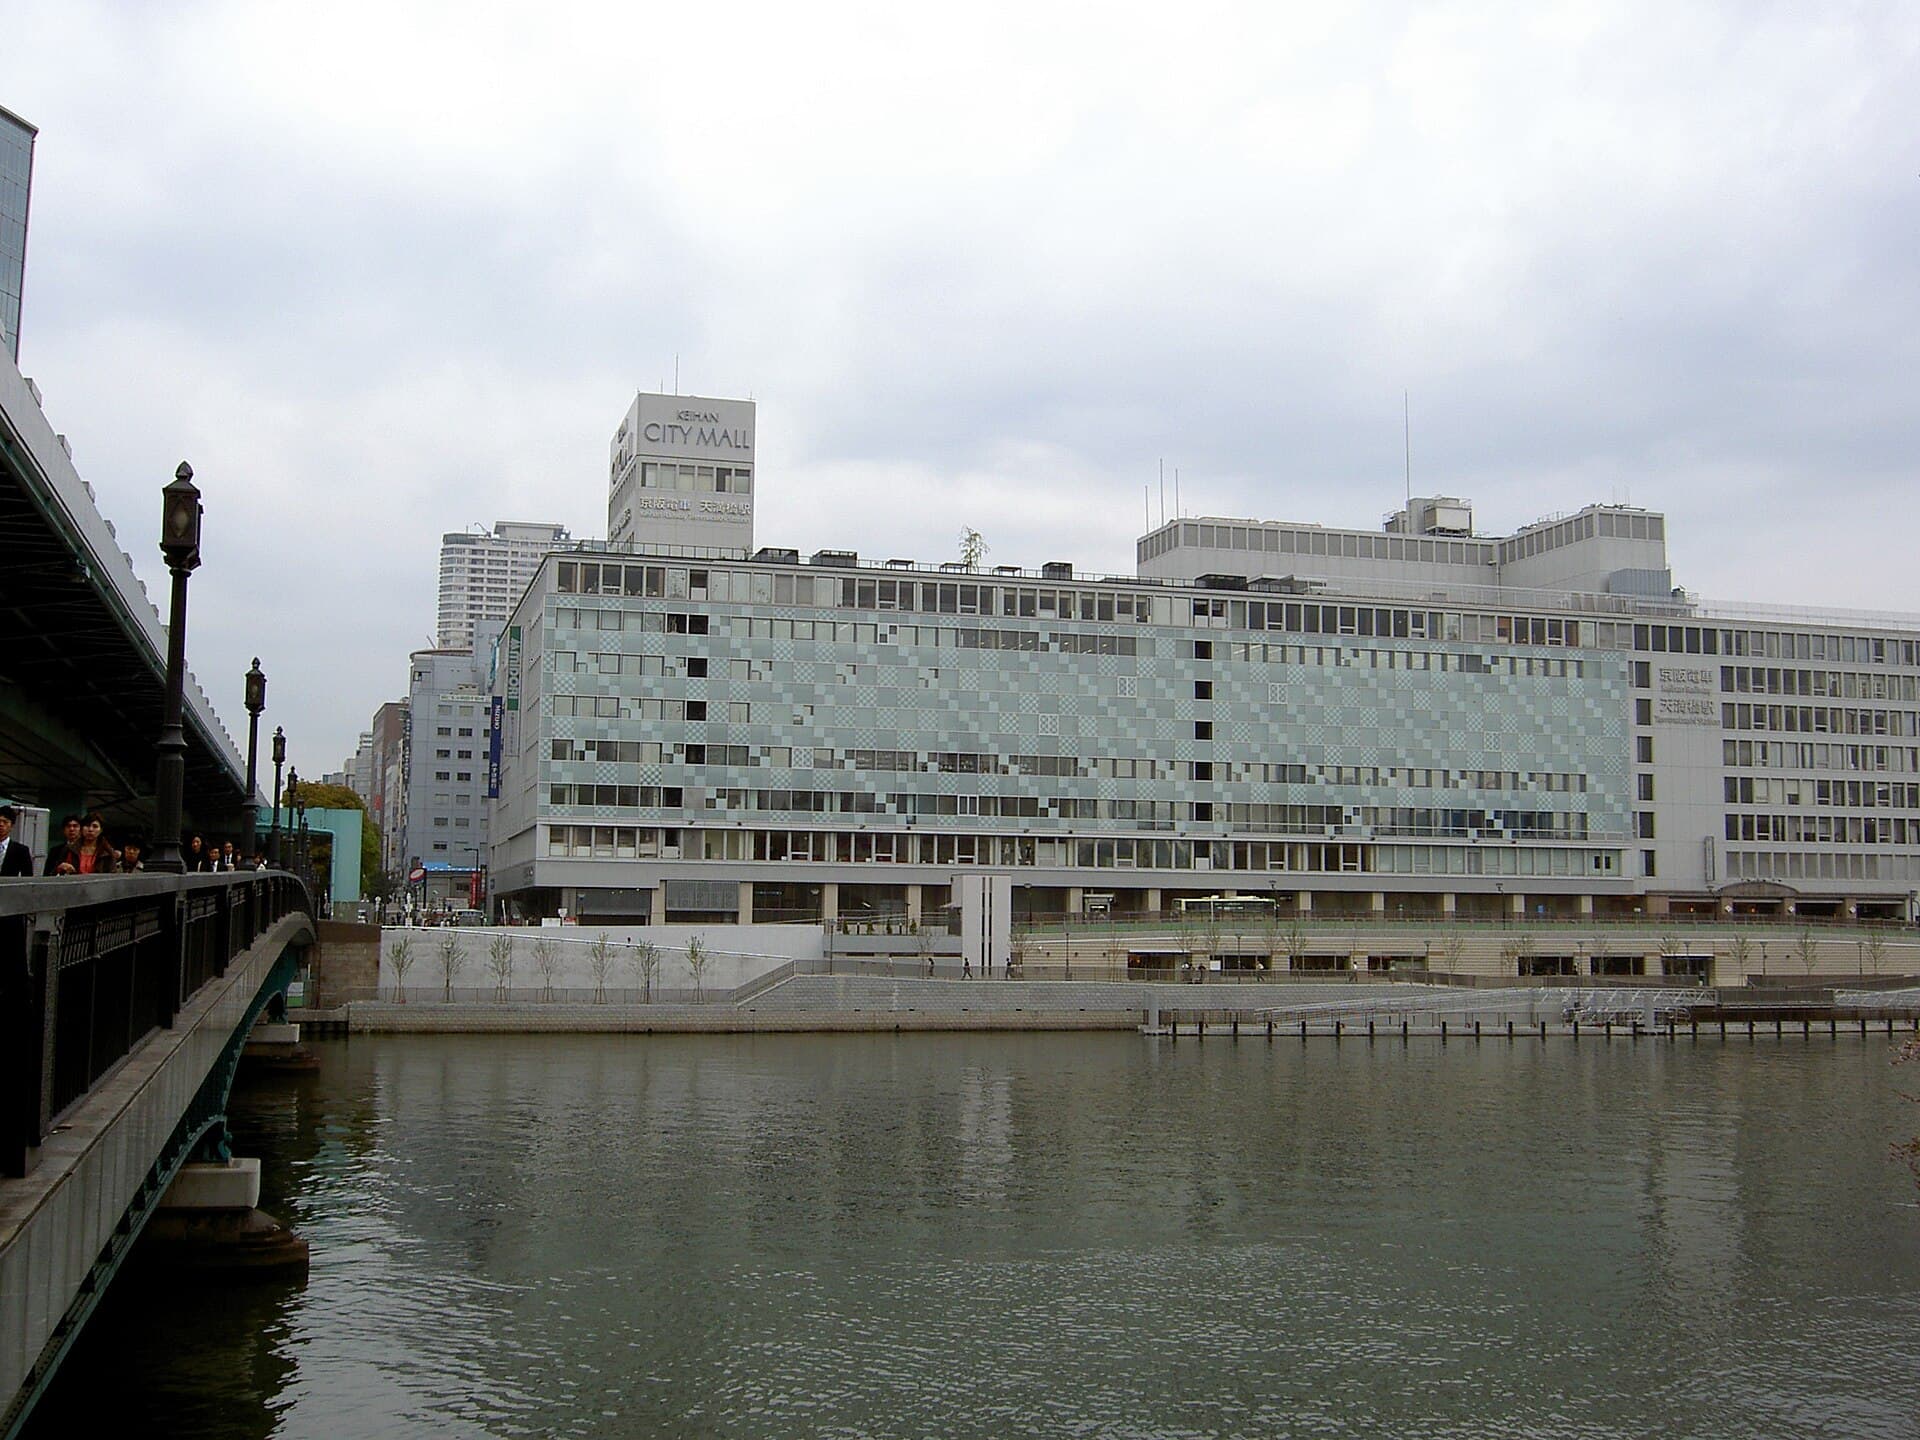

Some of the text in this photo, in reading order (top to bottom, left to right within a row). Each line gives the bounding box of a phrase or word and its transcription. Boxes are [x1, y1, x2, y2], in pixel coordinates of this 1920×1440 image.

[677, 410, 719, 423] KEIHAN
[644, 423, 750, 449] CITY MALL
